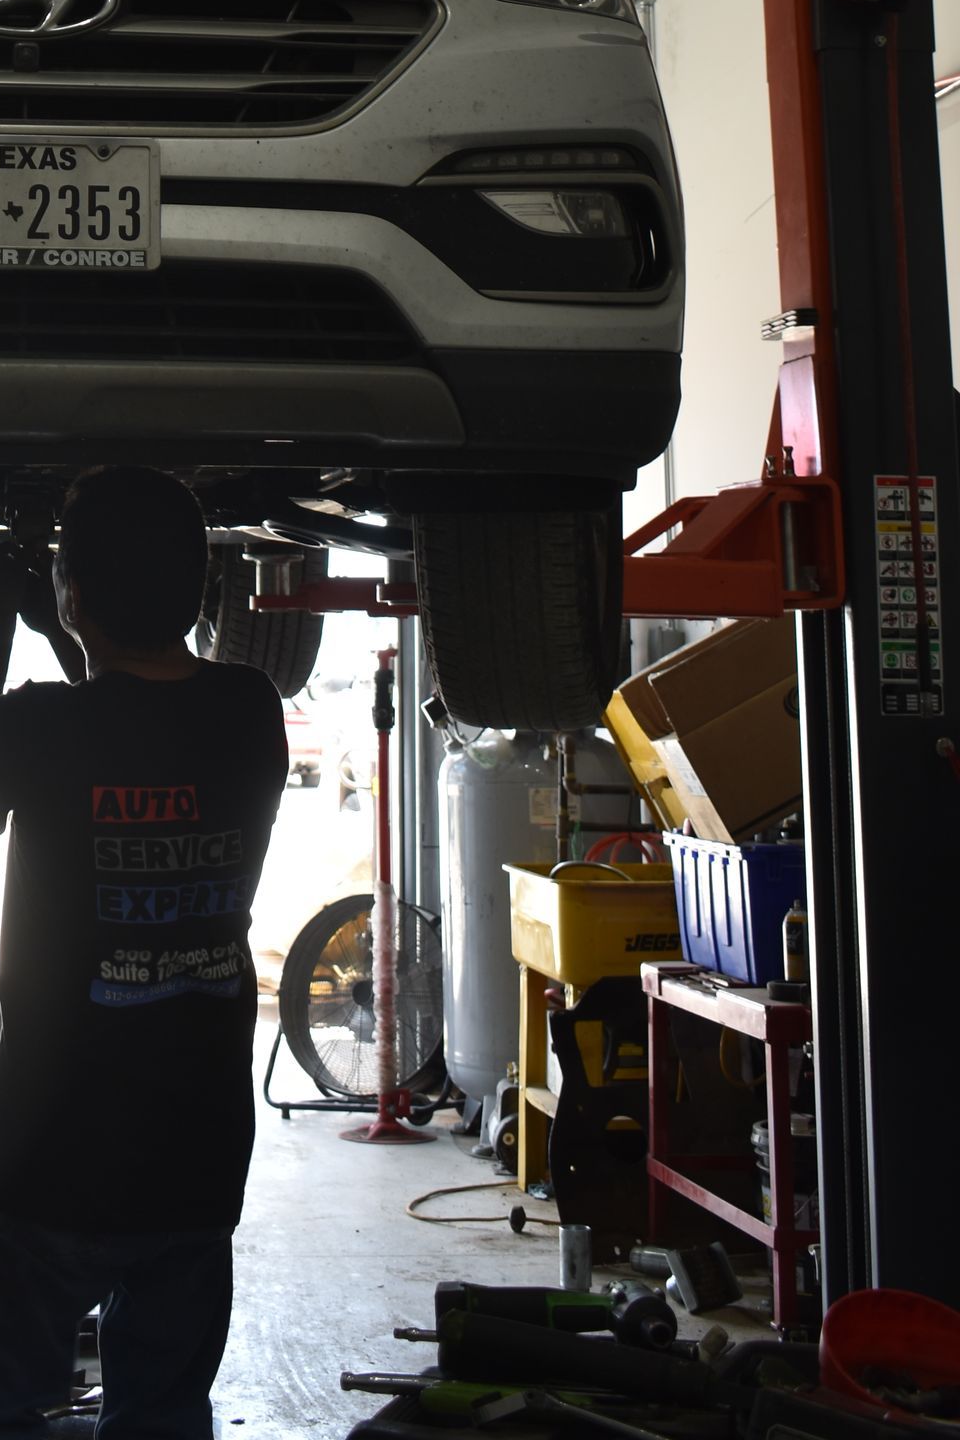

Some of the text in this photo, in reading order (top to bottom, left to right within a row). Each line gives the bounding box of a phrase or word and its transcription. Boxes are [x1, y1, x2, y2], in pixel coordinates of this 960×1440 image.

[43, 250, 146, 267] CONROE
[95, 788, 196, 820] AUTO
[95, 831, 241, 870] SERVICE
[100, 960, 150, 982] Suite
